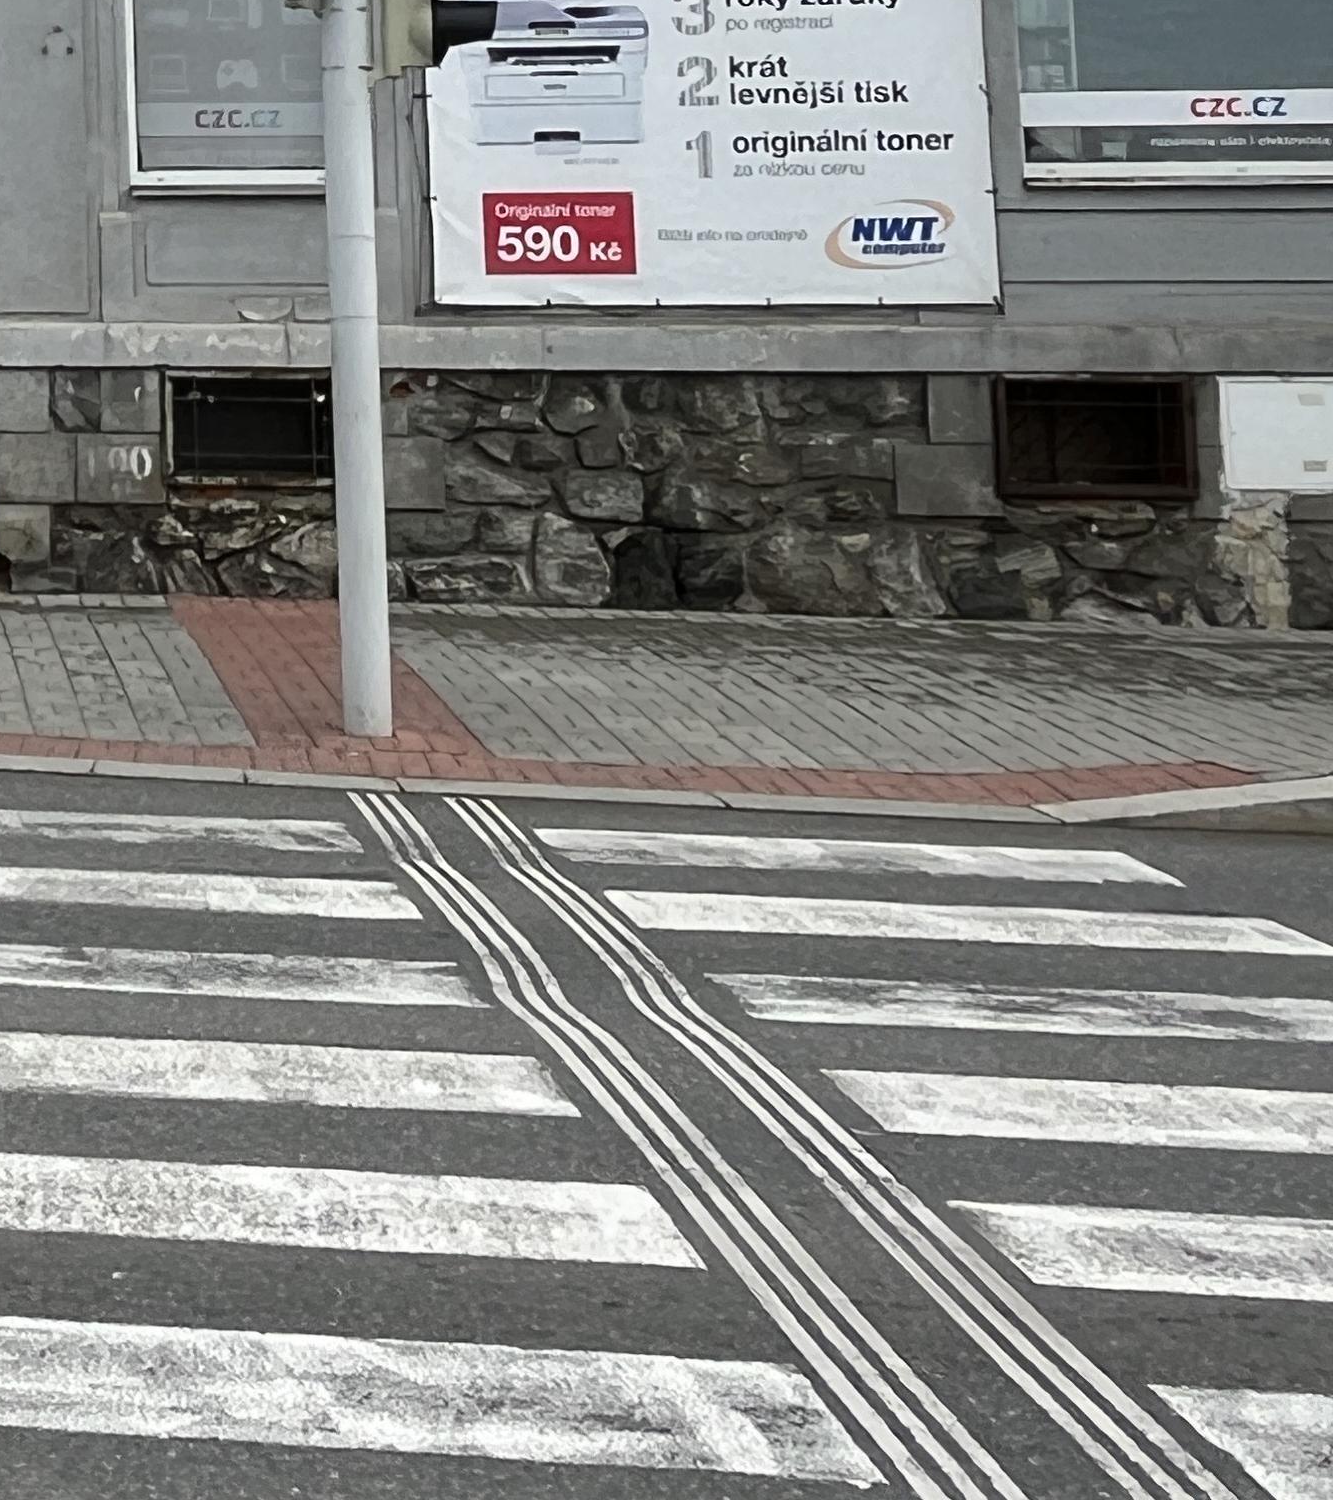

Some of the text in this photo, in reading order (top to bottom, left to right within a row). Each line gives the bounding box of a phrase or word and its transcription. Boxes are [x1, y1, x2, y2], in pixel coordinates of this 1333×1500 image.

[725, 18, 749, 34] po
[677, 54, 788, 107] 2 krát
[729, 80, 910, 109] levnější tisk
[1190, 97, 1288, 118] CZC.CZ
[195, 109, 282, 129] CZC.CZ
[685, 128, 954, 180] 1 originální toner
[852, 216, 940, 242] NWT
[496, 225, 623, 262] 590 Kč
